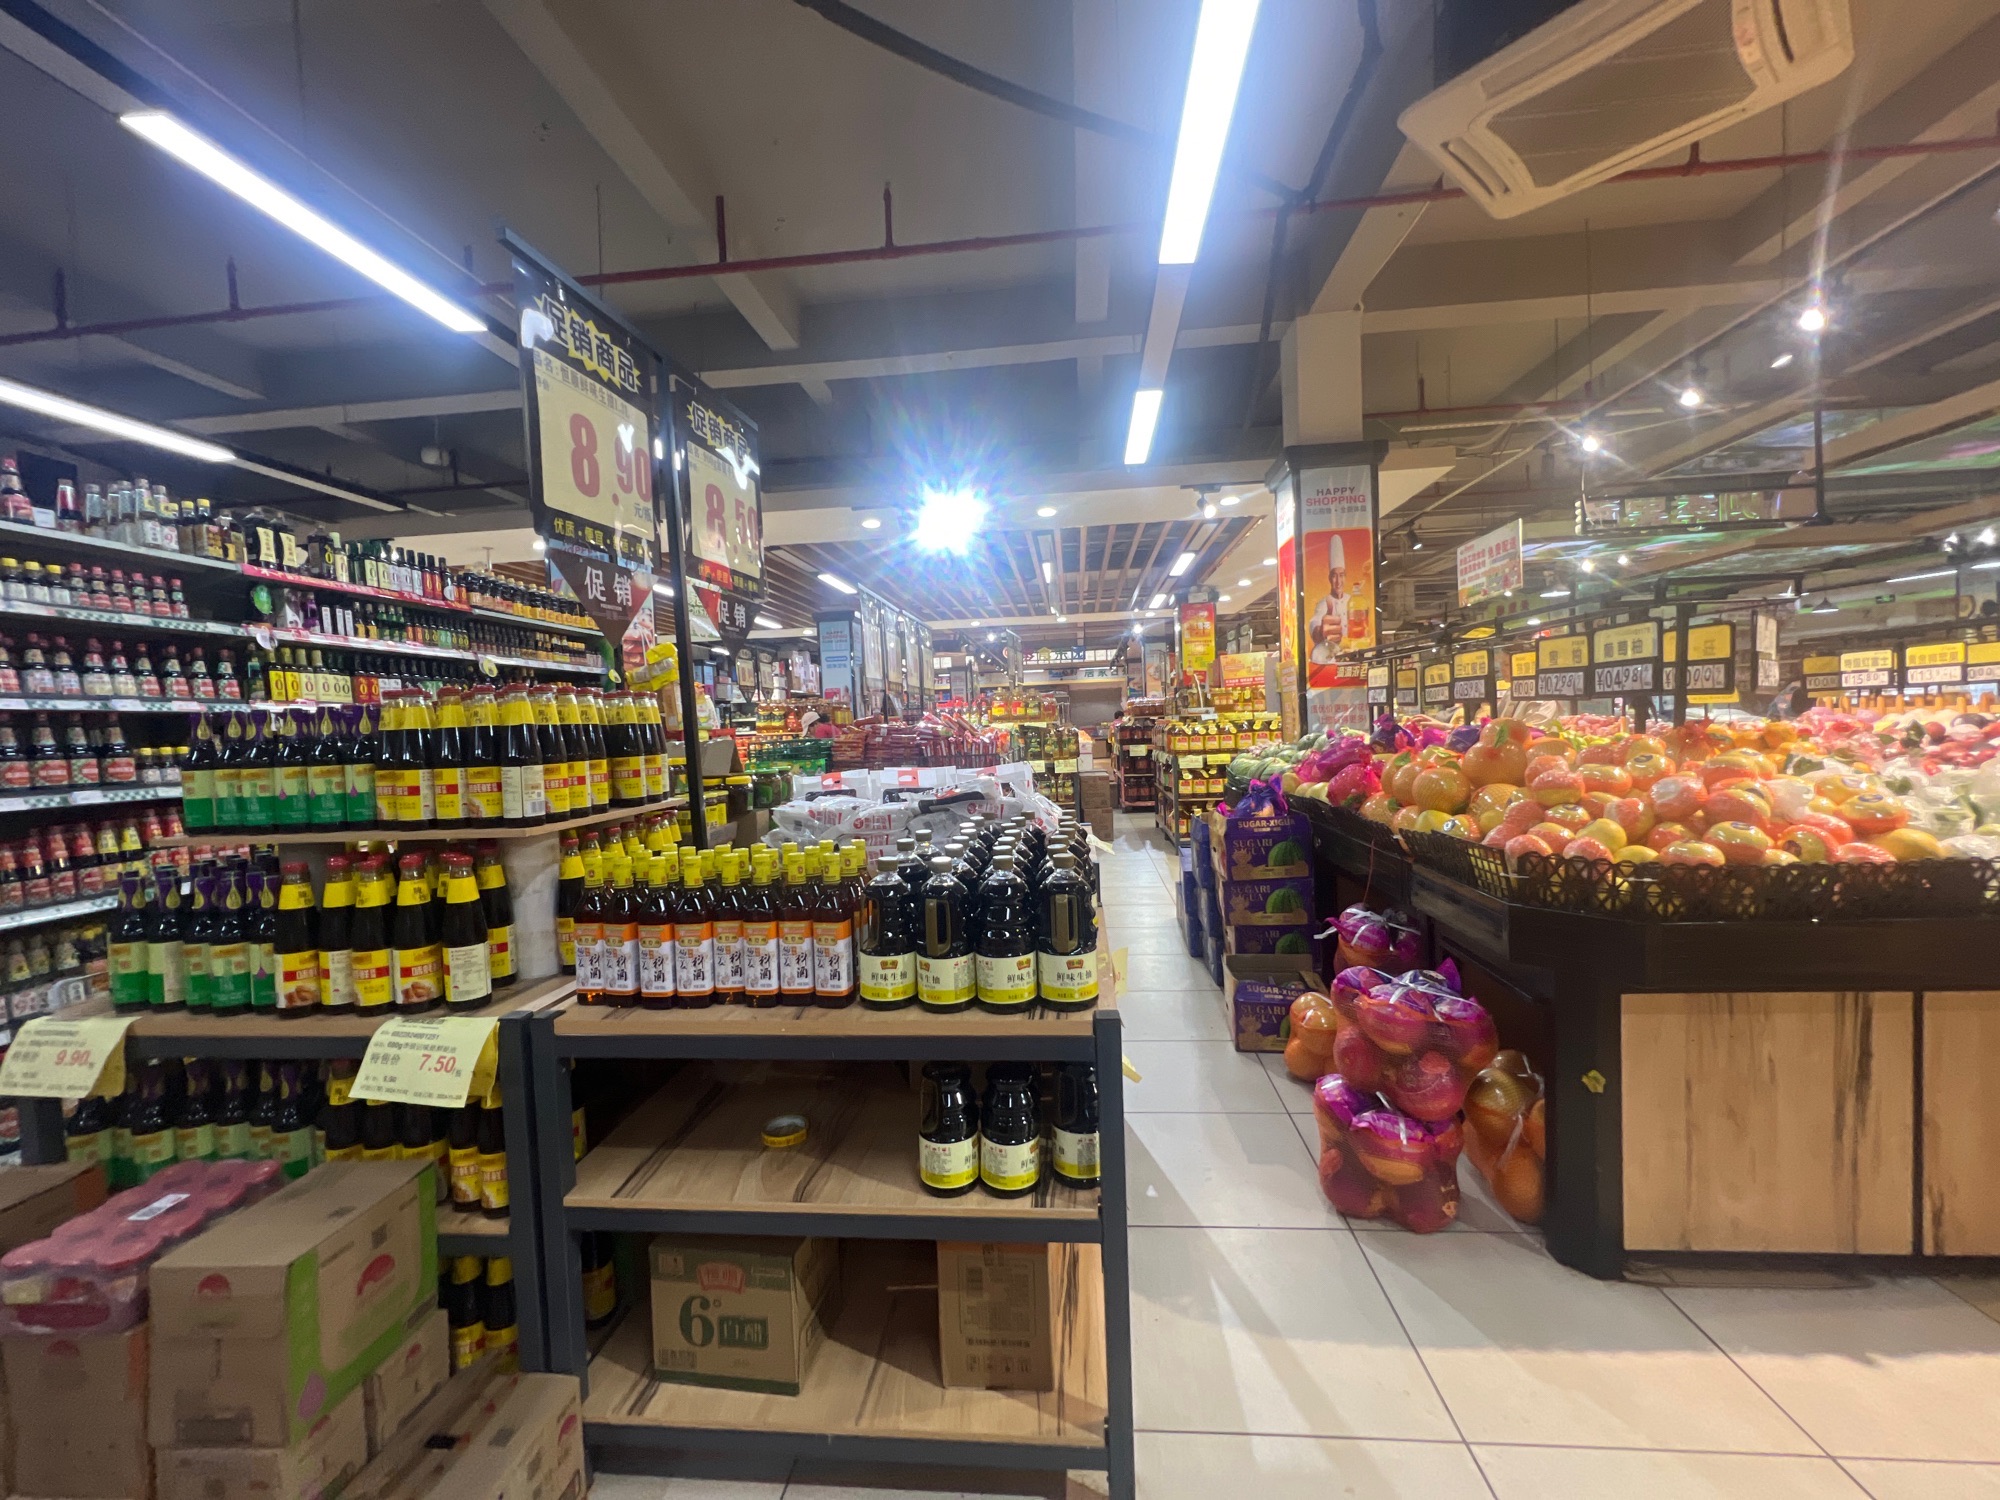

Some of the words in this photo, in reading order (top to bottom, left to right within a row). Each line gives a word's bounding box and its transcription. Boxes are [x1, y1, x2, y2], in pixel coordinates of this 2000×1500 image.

[541, 293, 638, 393] 促销商品
[569, 412, 652, 506] 8.90
[1305, 494, 1366, 507] SHOPPING
[1316, 487, 1356, 497] HAPPY
[705, 483, 758, 554] 8.50
[584, 565, 632, 607] 促销
[716, 599, 746, 628] 促销
[1237, 818, 1295, 829] SUGAR-XIGUA
[55, 1049, 91, 1066] 9.90
[419, 1053, 457, 1074] 7.50
